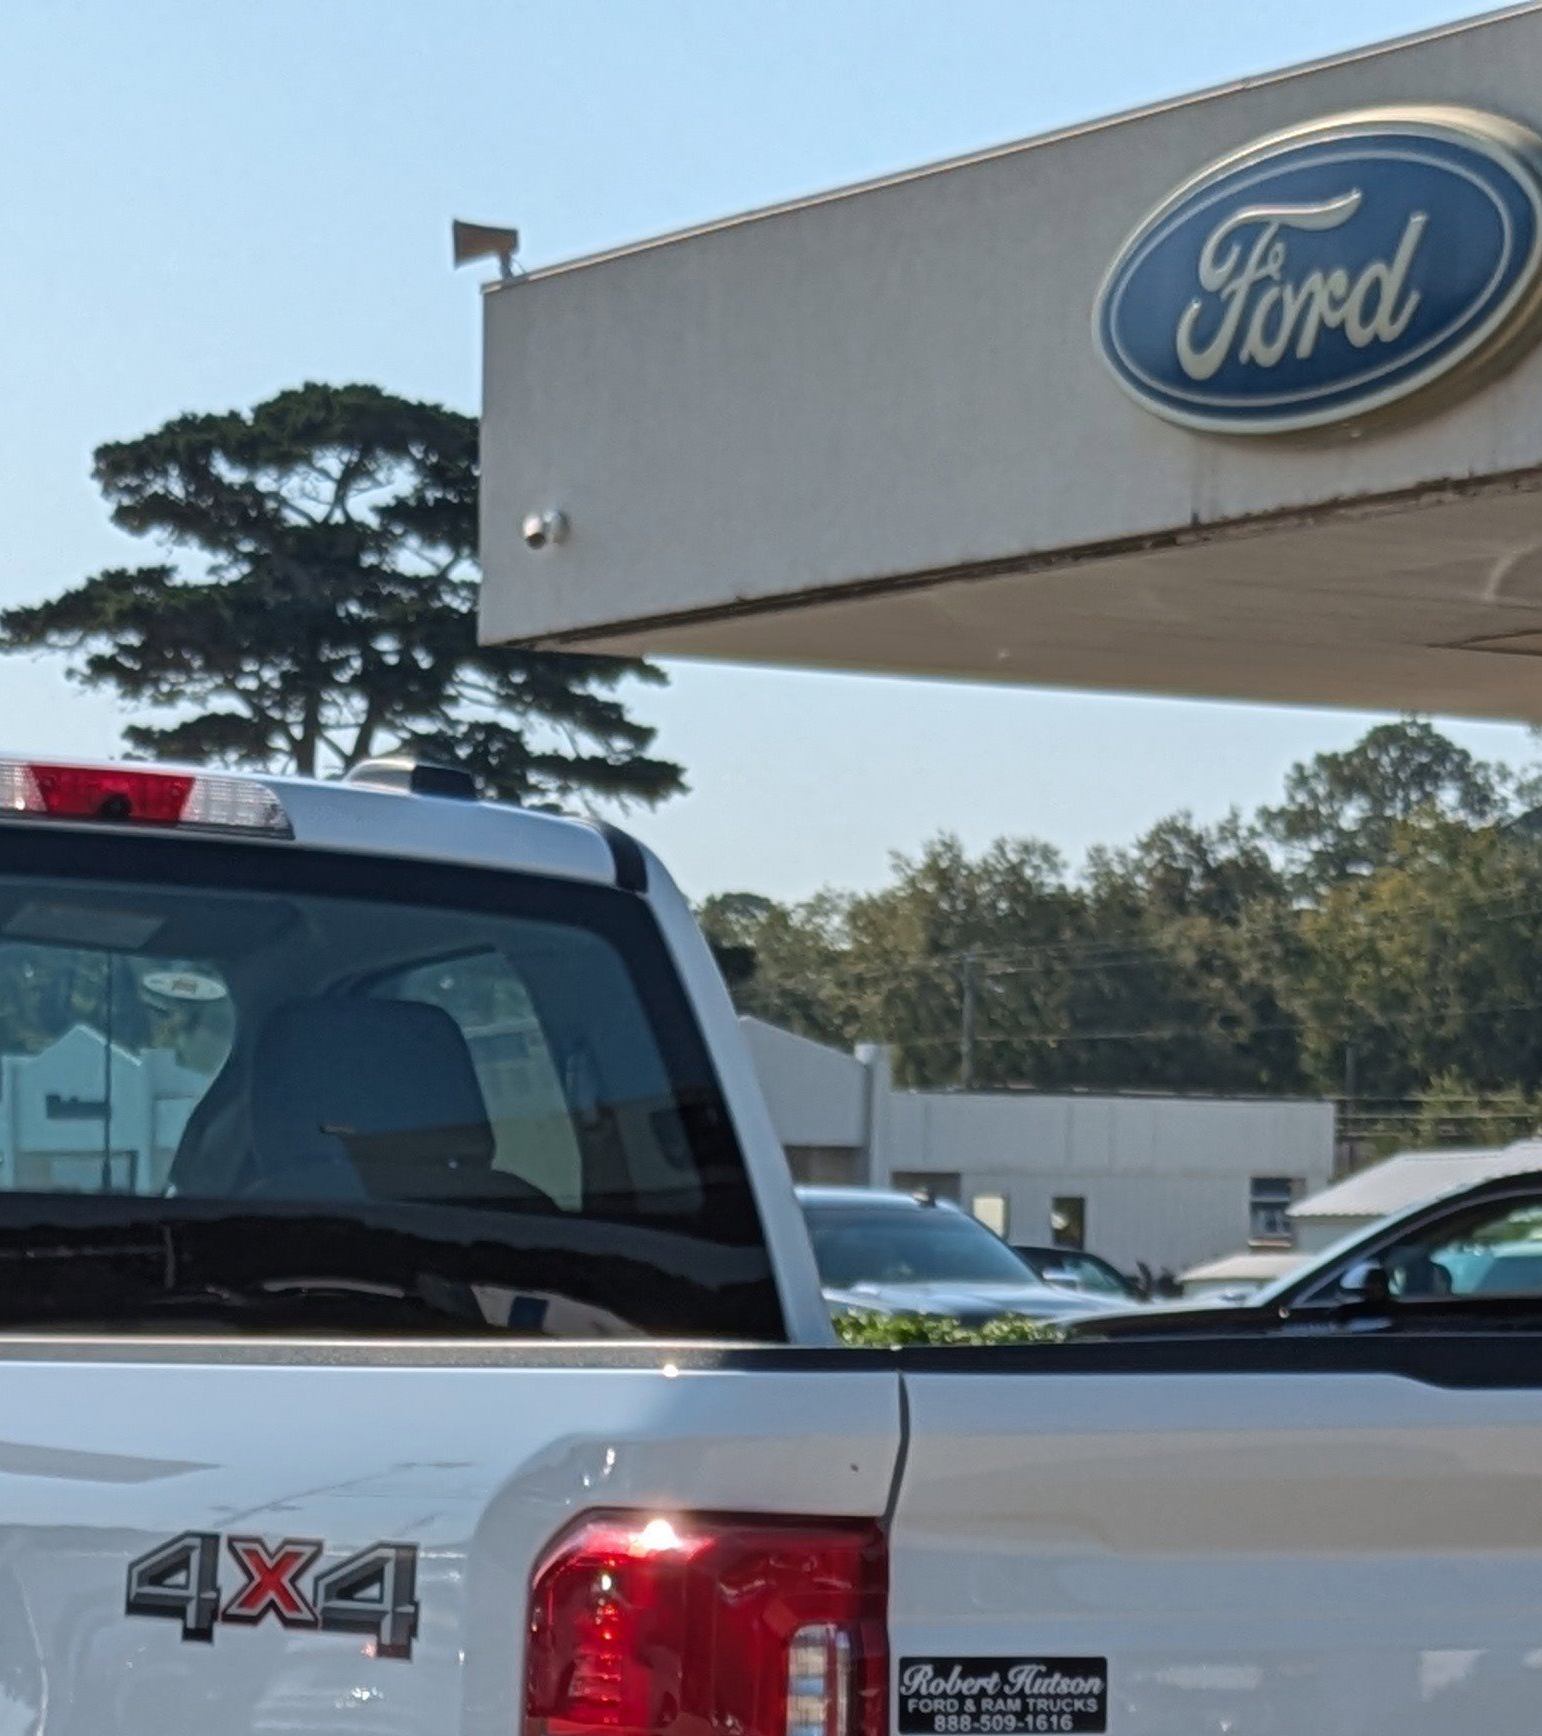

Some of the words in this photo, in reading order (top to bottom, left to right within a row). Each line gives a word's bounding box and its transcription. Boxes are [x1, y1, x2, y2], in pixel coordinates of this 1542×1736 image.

[1176, 186, 1428, 382] Ford
[899, 1664, 1002, 1696] Robert
[1003, 1664, 1104, 1695] Hutson
[907, 1698, 959, 1714] FORD
[963, 1698, 977, 1713] &
[981, 1698, 1022, 1712] RAM
[1026, 1698, 1099, 1713] TRUCKS
[933, 1714, 1074, 1733] 888-509-1616
